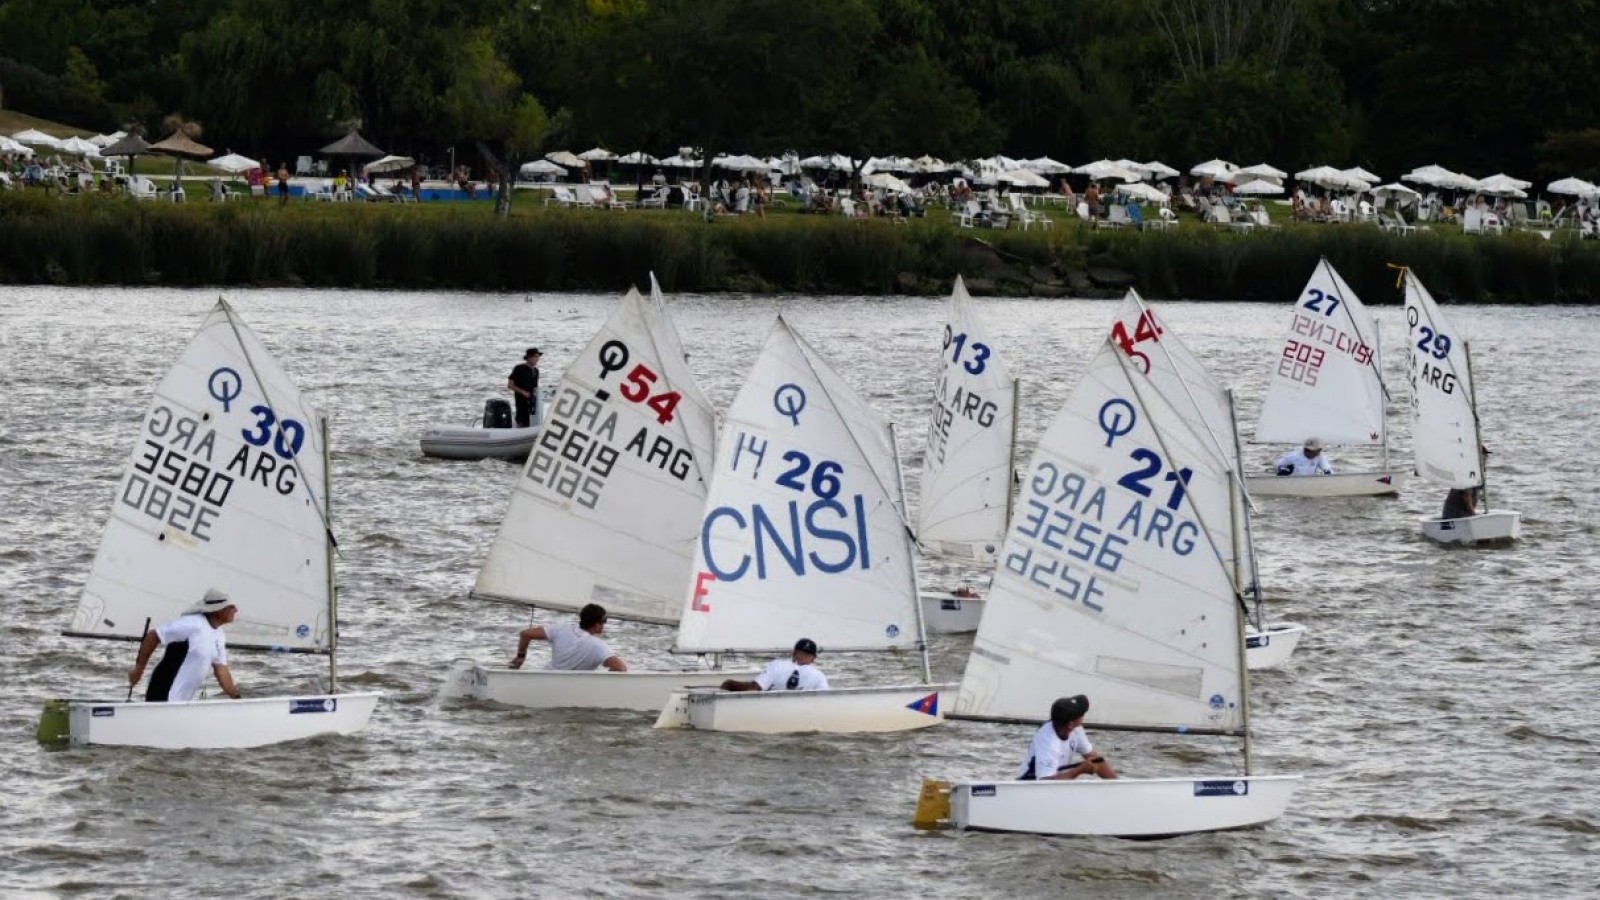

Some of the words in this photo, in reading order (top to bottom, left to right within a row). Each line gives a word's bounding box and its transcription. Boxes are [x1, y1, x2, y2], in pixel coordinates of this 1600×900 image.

[1303, 288, 1340, 317] 27
[952, 332, 991, 375] 13
[1283, 339, 1325, 368] 203
[1417, 326, 1451, 360] 29
[619, 363, 682, 425] 54
[1421, 362, 1456, 395] ARG
[242, 405, 305, 460] 30
[951, 386, 998, 428] ARG
[134, 439, 235, 507] 3580
[226, 444, 297, 495] ARG
[539, 419, 620, 478] 2619
[624, 426, 693, 481] ARG
[775, 450, 844, 500] 26
[1117, 447, 1193, 511] 21
[701, 494, 870, 582] CNSI
[1016, 499, 1129, 572] 3256
[1117, 500, 1199, 556] ARG
